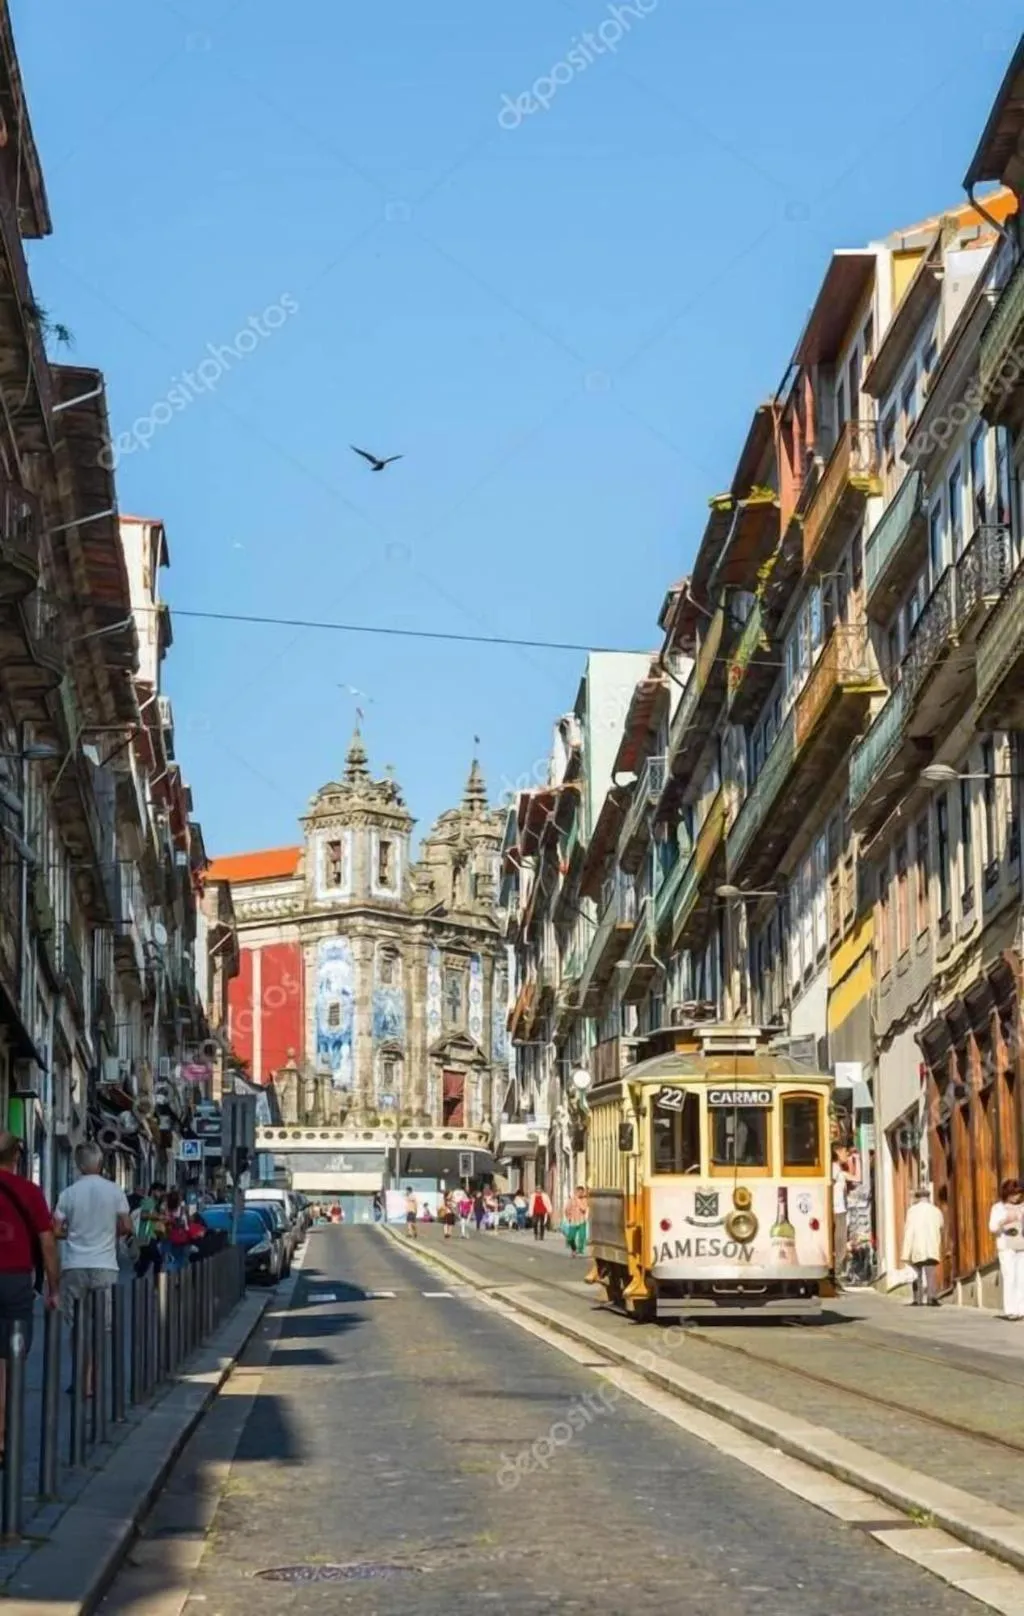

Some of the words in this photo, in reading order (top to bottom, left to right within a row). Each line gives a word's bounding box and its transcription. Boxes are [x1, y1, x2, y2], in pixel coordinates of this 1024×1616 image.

[660, 1087, 683, 1107] 22
[709, 1091, 770, 1104] CARMO
[652, 1238, 755, 1267] JAMESON
